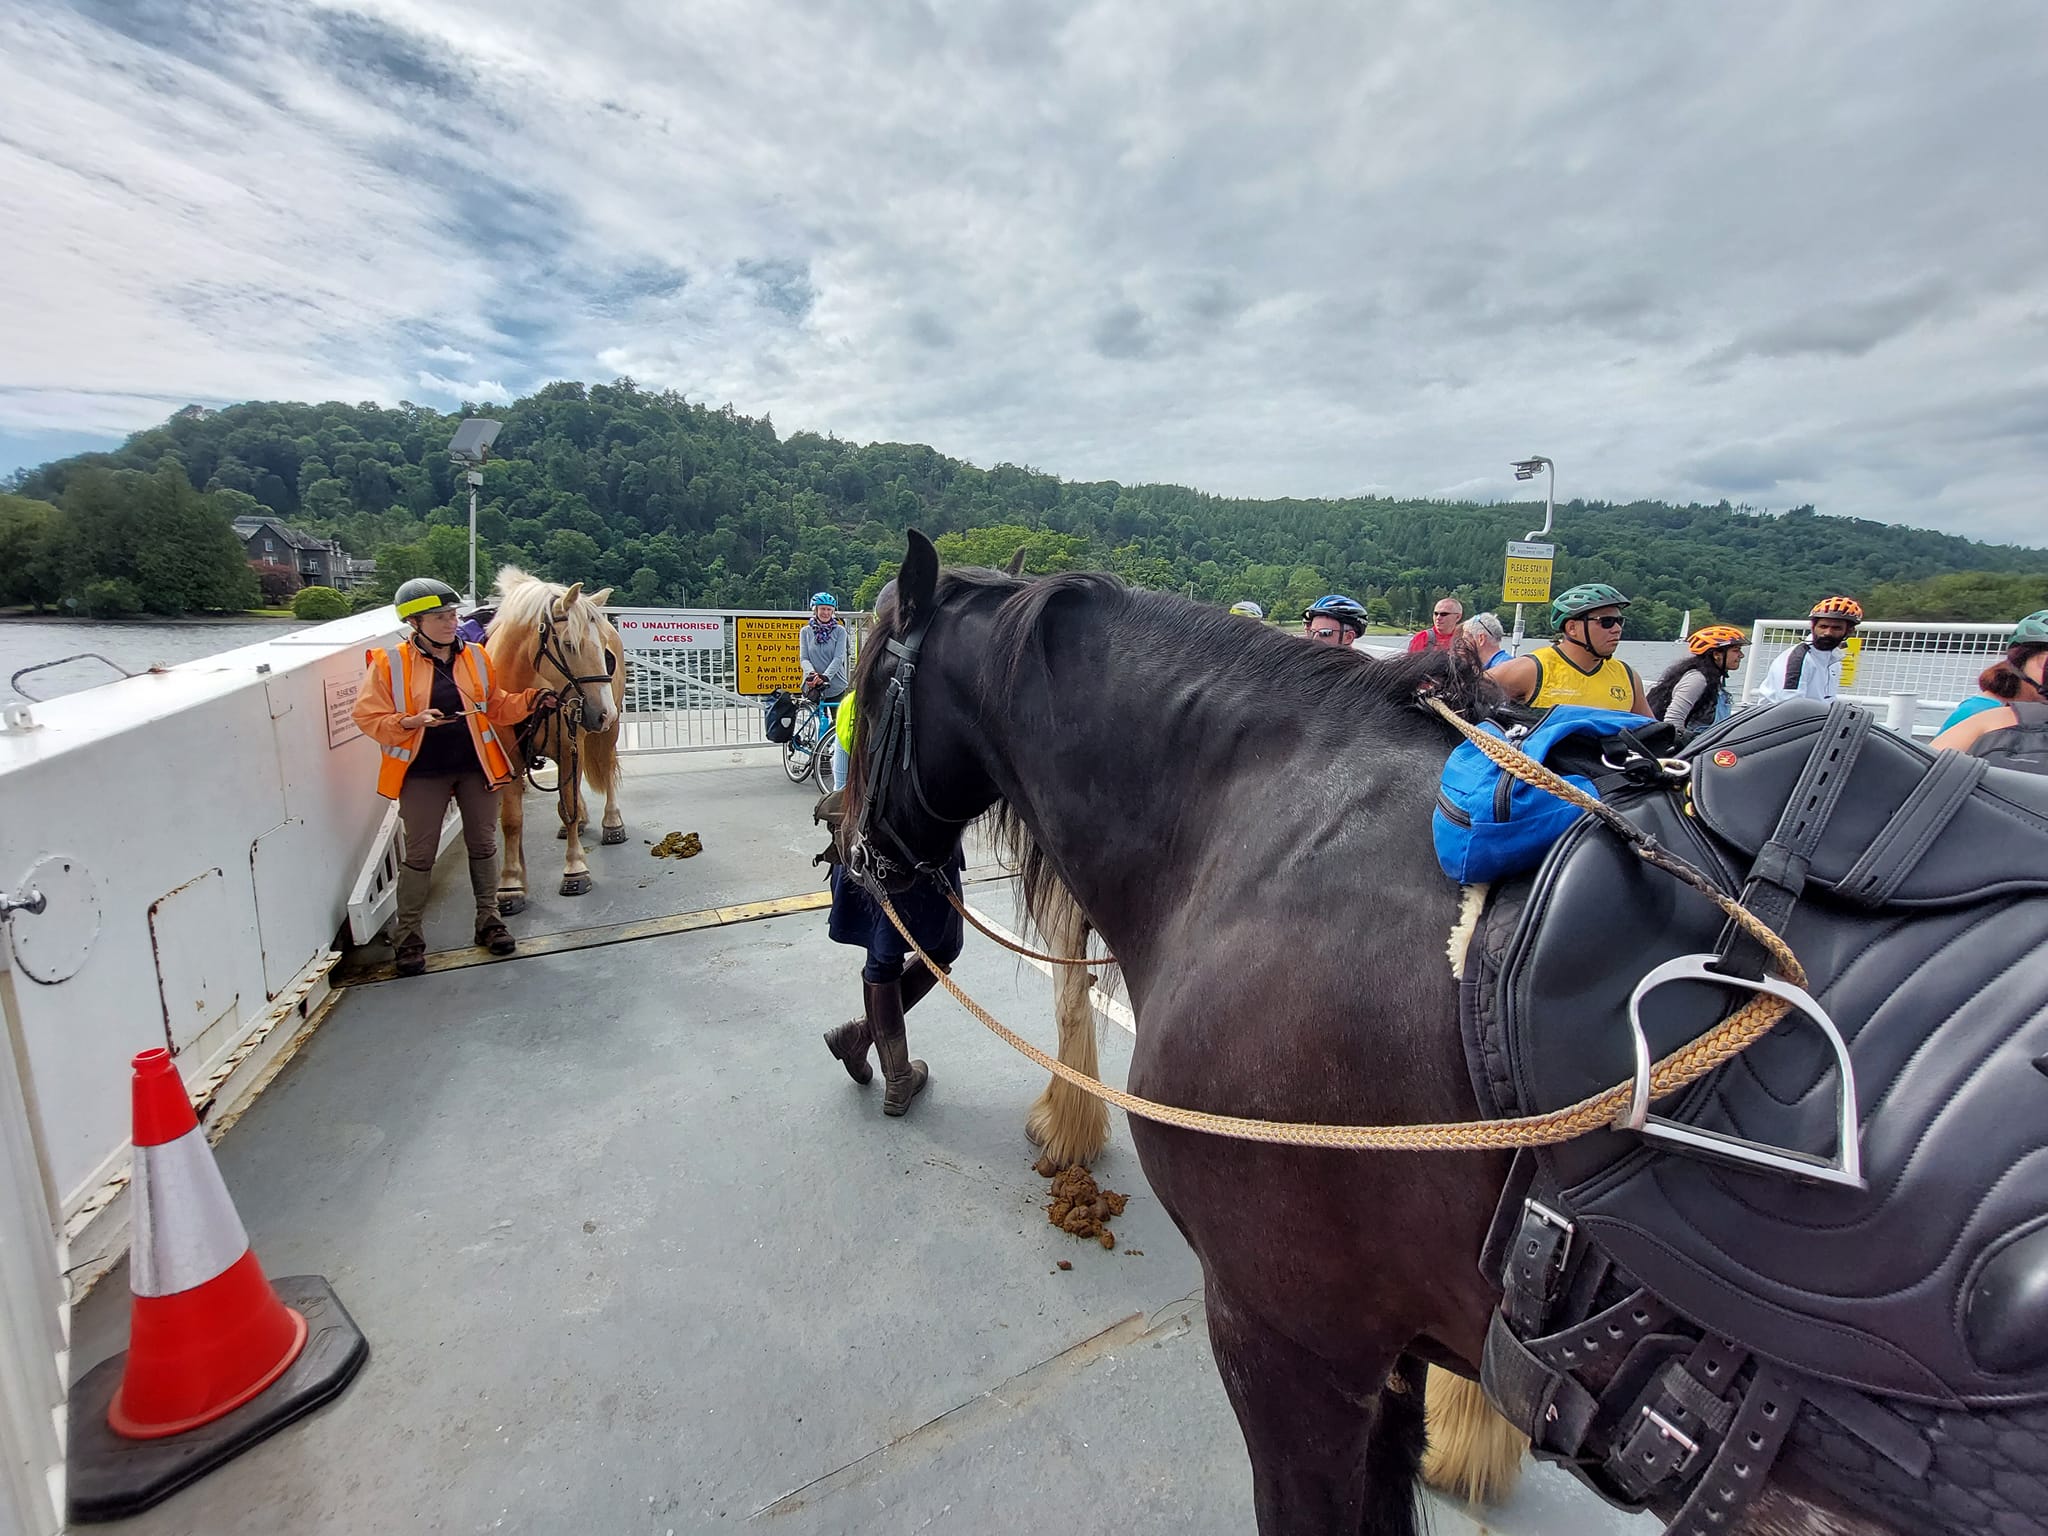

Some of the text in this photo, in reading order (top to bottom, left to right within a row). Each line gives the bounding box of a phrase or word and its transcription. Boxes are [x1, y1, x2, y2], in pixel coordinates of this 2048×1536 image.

[1511, 563, 1548, 573] PLEASE STAY IN
[1507, 576, 1549, 585] VEHICLES DURING
[1510, 588, 1545, 597] THE CROSSING
[622, 621, 719, 630] NO UNAUTHORISED
[653, 635, 693, 643] ACCESS
[757, 644, 781, 653] Apply
[757, 682, 801, 690] disembark
